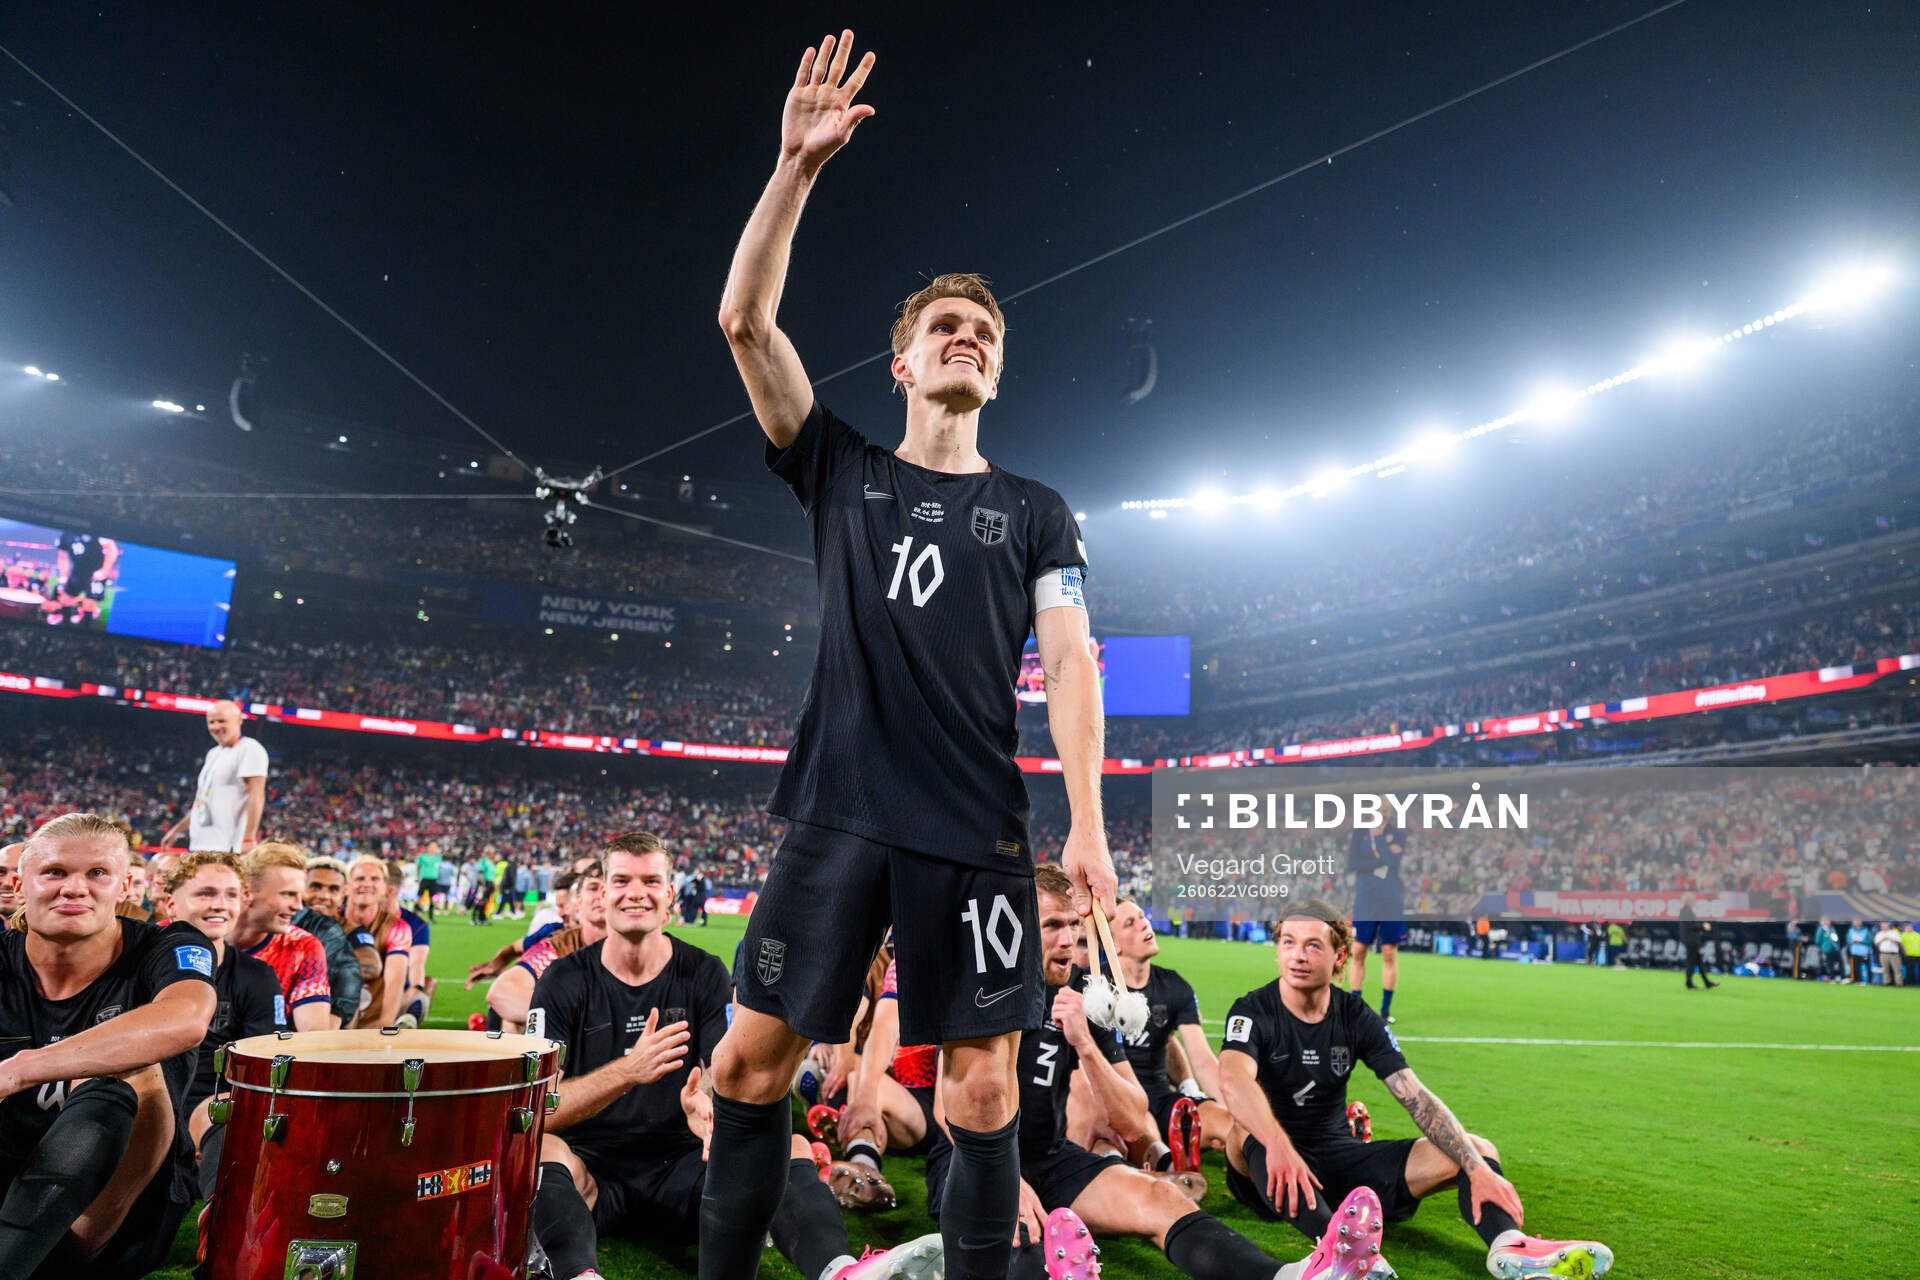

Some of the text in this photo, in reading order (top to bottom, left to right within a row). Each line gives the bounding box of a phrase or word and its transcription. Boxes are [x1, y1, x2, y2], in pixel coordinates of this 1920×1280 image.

[887, 536, 944, 607] 10
[540, 609, 675, 633] NEW JERSEY
[541, 595, 675, 619] NEW YORK
[1634, 898, 1666, 917] CUP
[961, 894, 1023, 974] 10
[1032, 1041, 1059, 1087] 3
